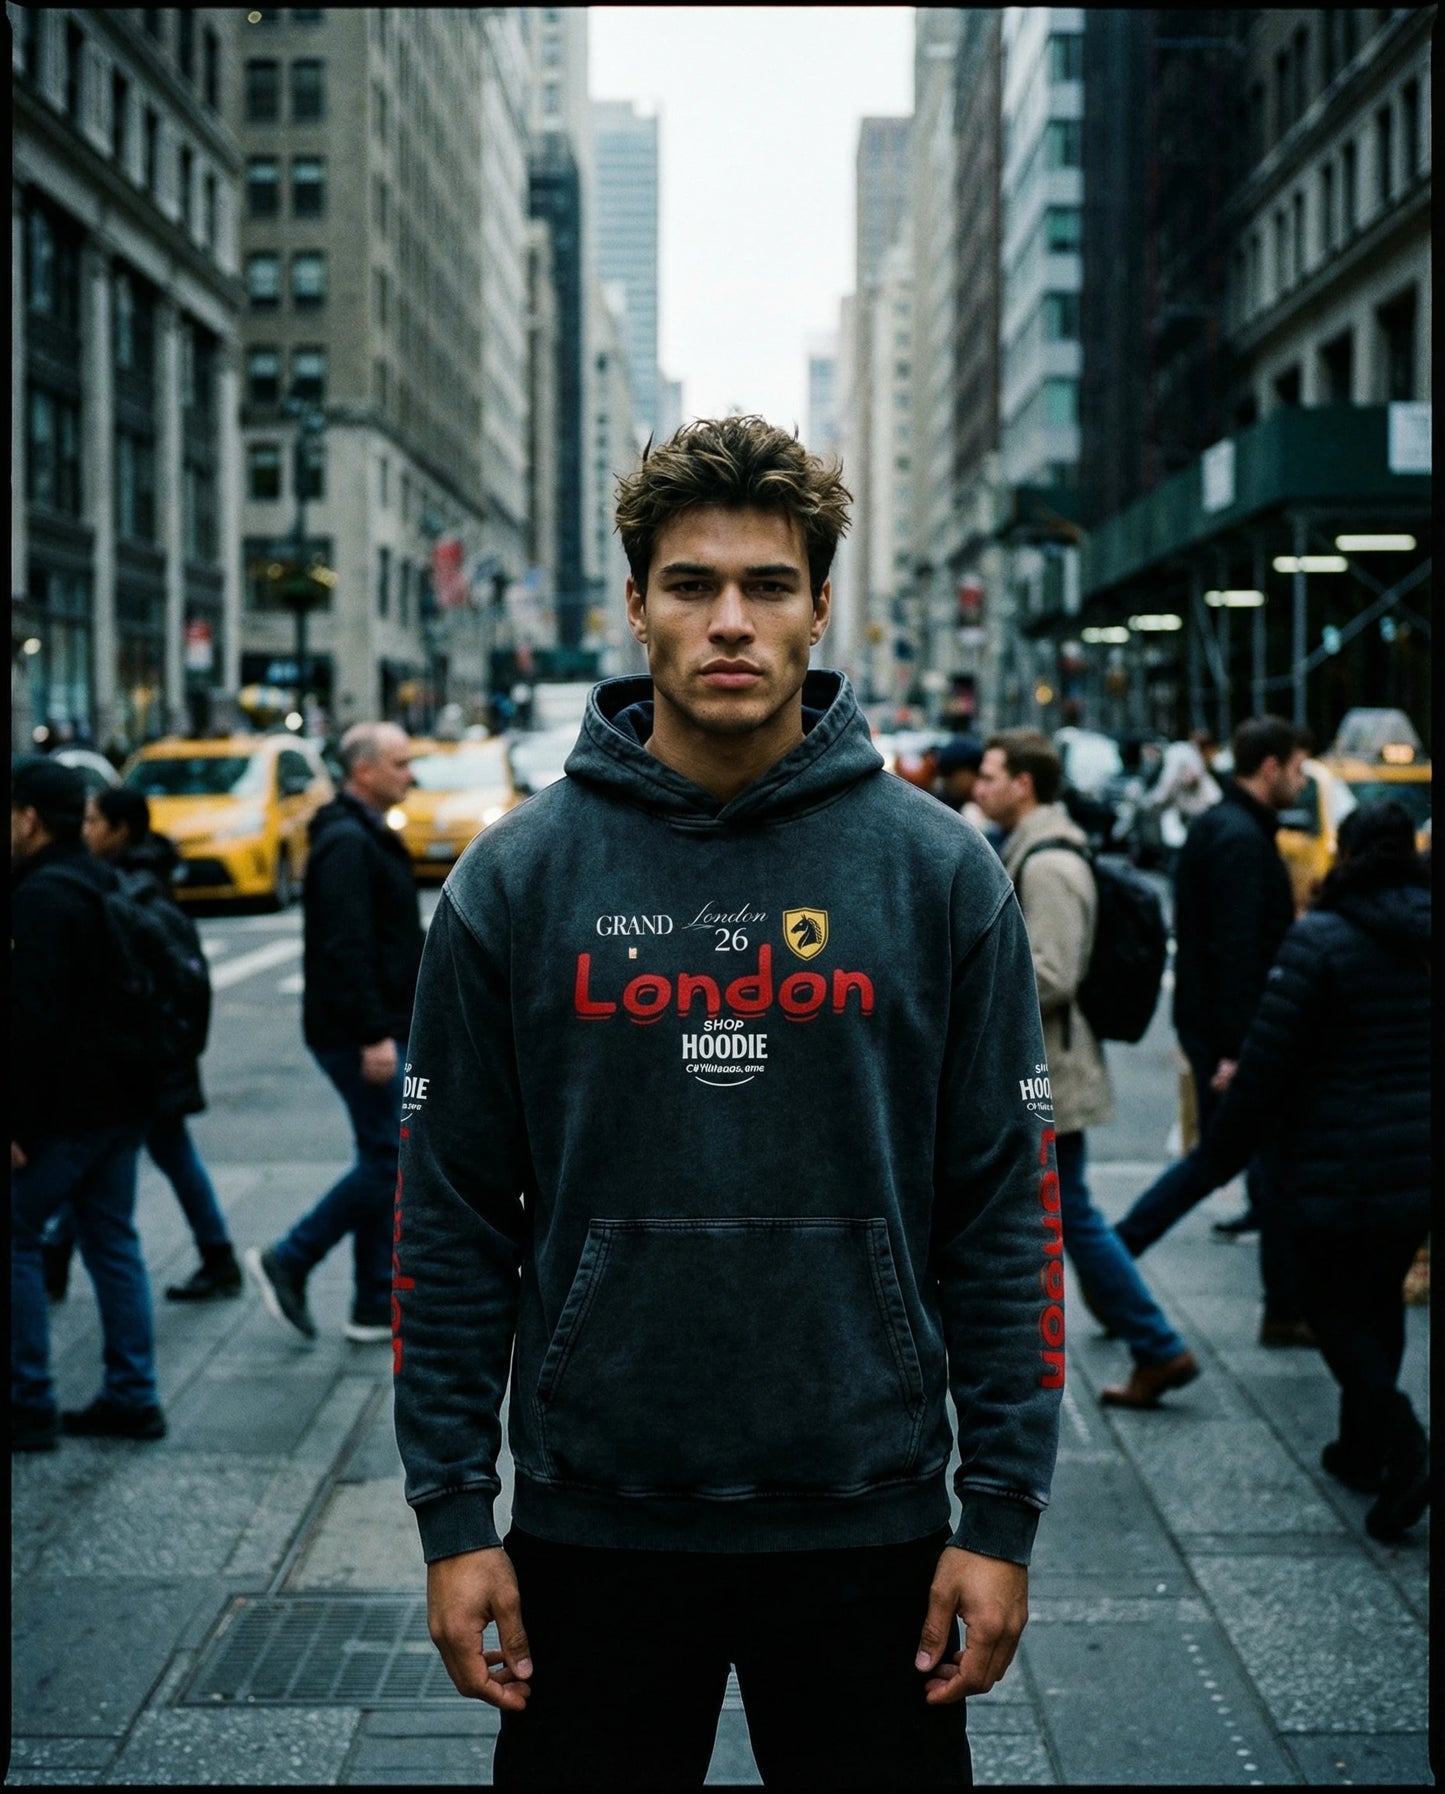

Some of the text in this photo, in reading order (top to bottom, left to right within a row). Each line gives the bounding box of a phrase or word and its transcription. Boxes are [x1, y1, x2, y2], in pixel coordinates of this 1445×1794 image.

[596, 914, 674, 937] GRAND
[682, 900, 768, 931] London
[714, 927, 749, 952] 26
[573, 943, 875, 1023] London
[703, 1018, 745, 1032] SHOP
[681, 1033, 769, 1060] HOODIE
[1018, 1076, 1053, 1101] HOO
